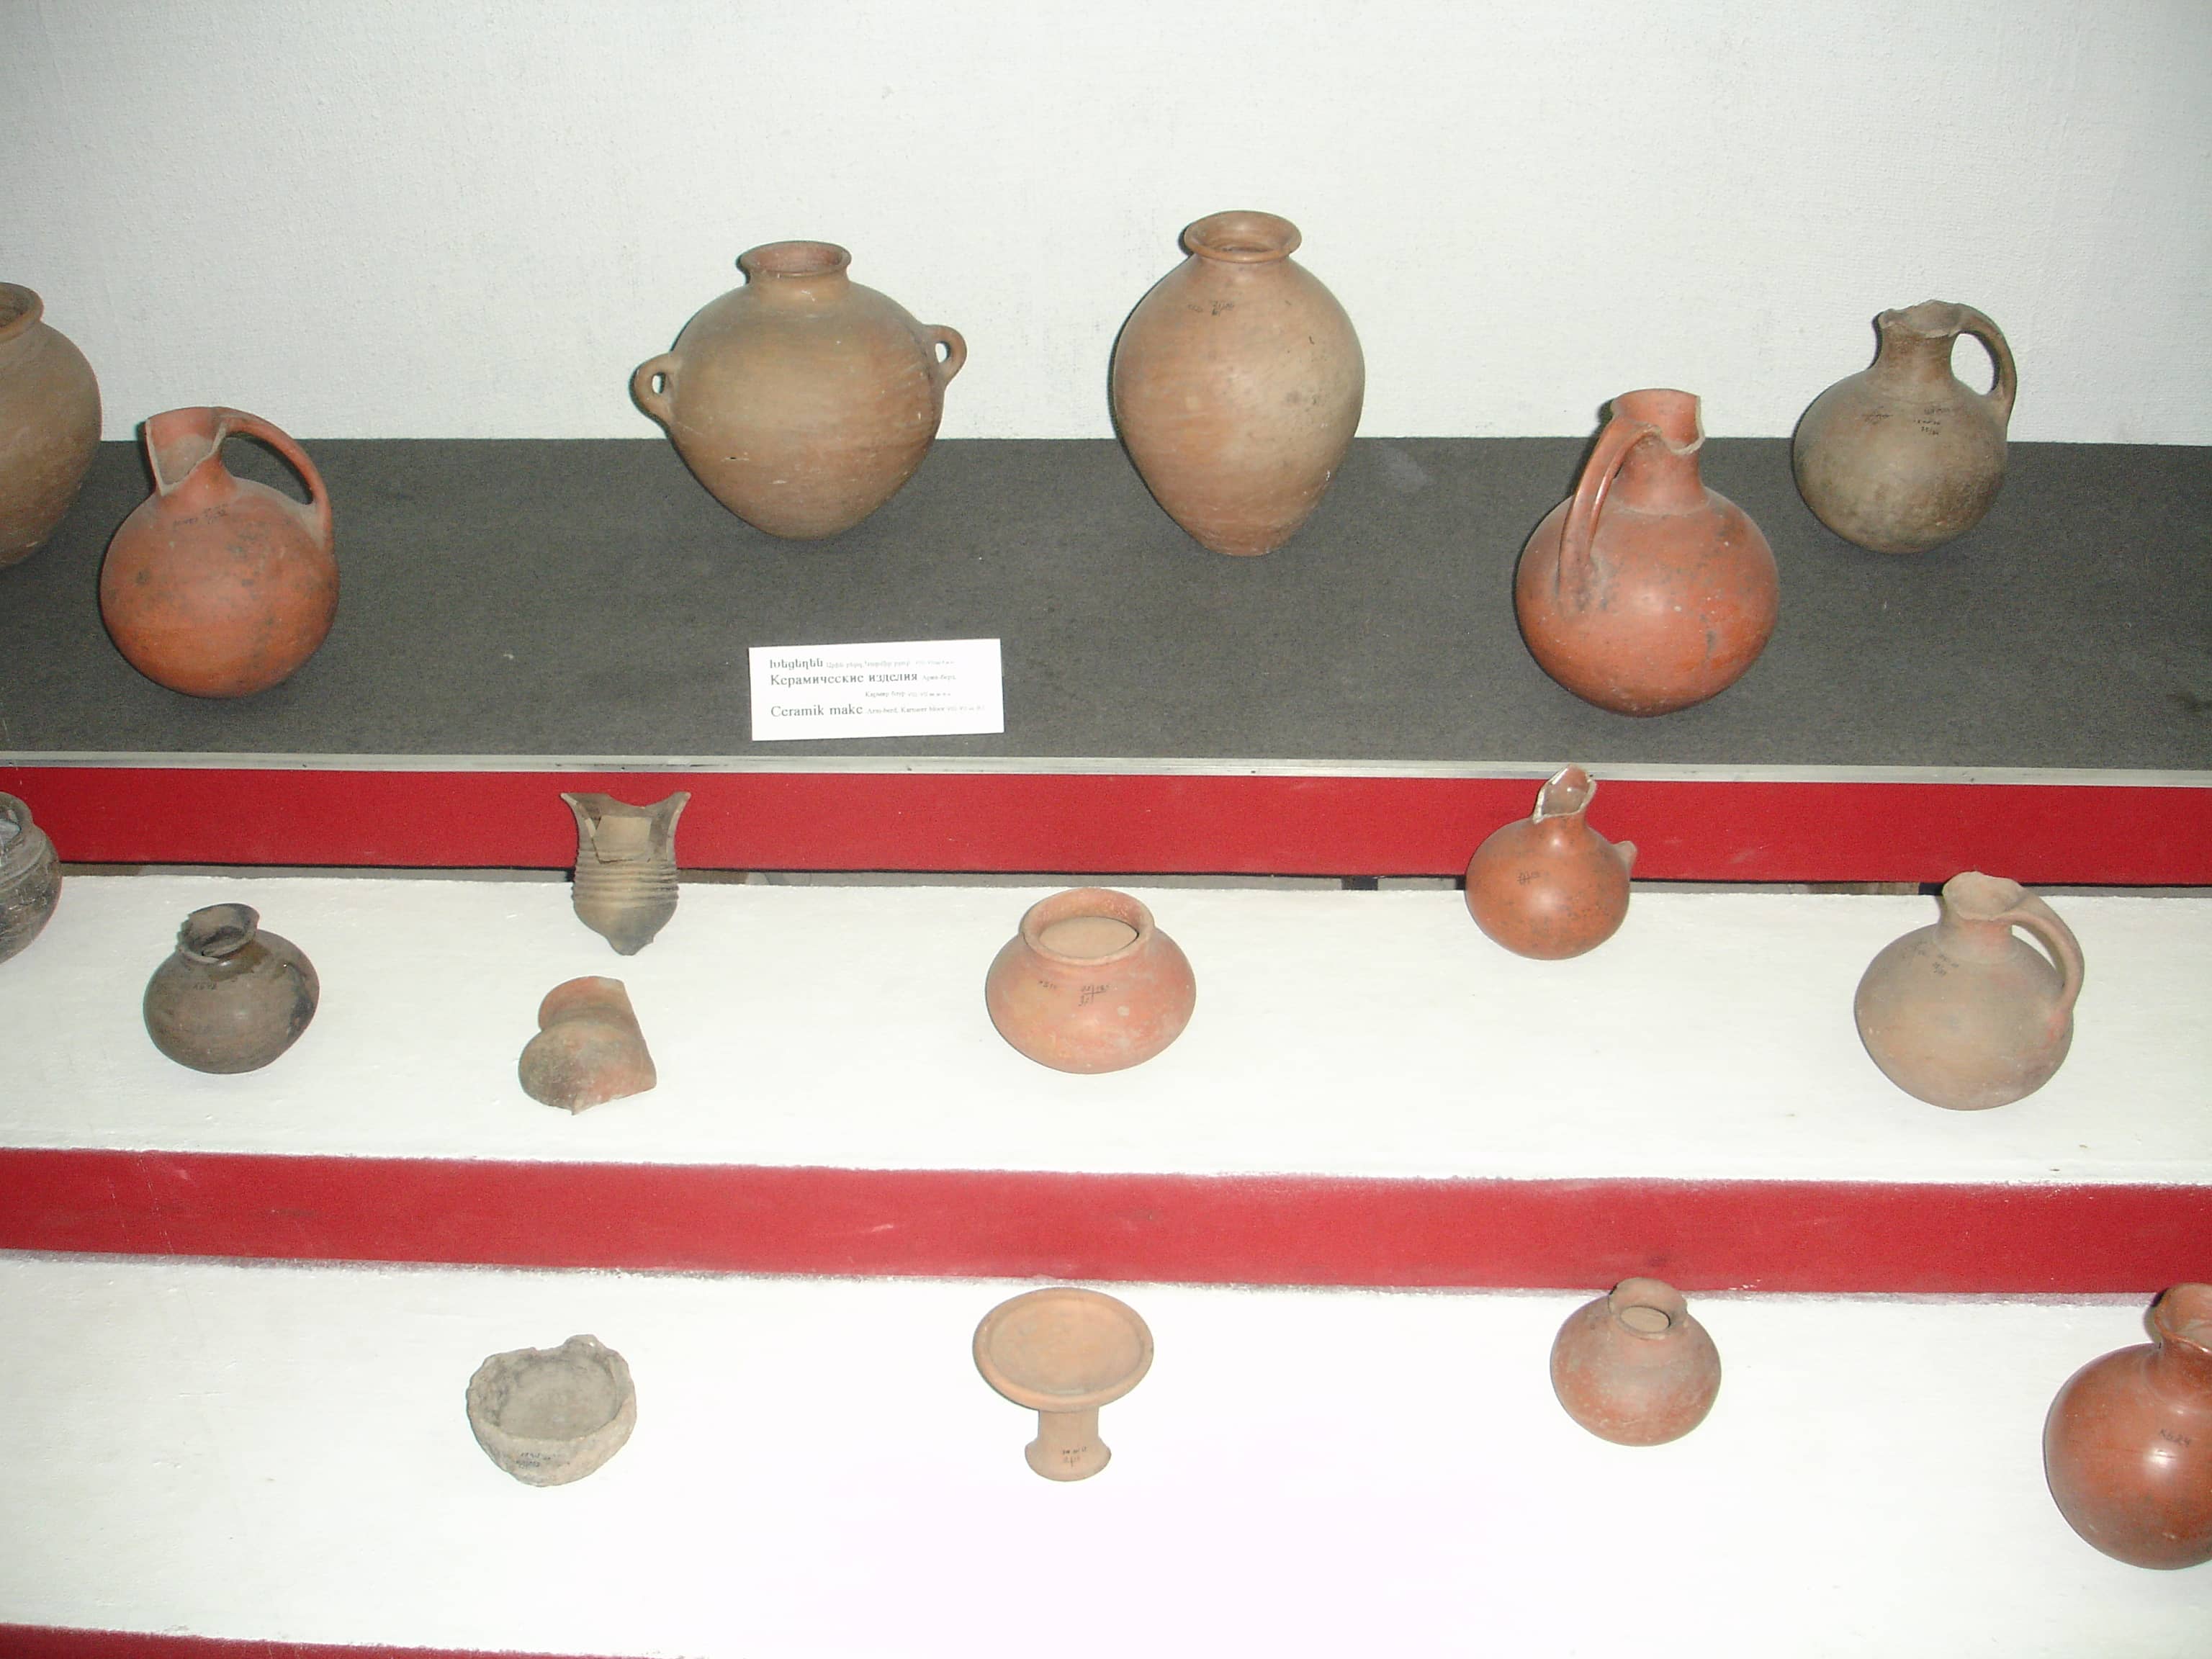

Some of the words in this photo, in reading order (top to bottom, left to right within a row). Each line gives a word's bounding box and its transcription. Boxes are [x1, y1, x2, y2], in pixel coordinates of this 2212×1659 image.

[770, 674, 864, 688] Керамические
[869, 673, 918, 683] изделия
[770, 704, 824, 717] Ceramik
[830, 703, 864, 715] make
